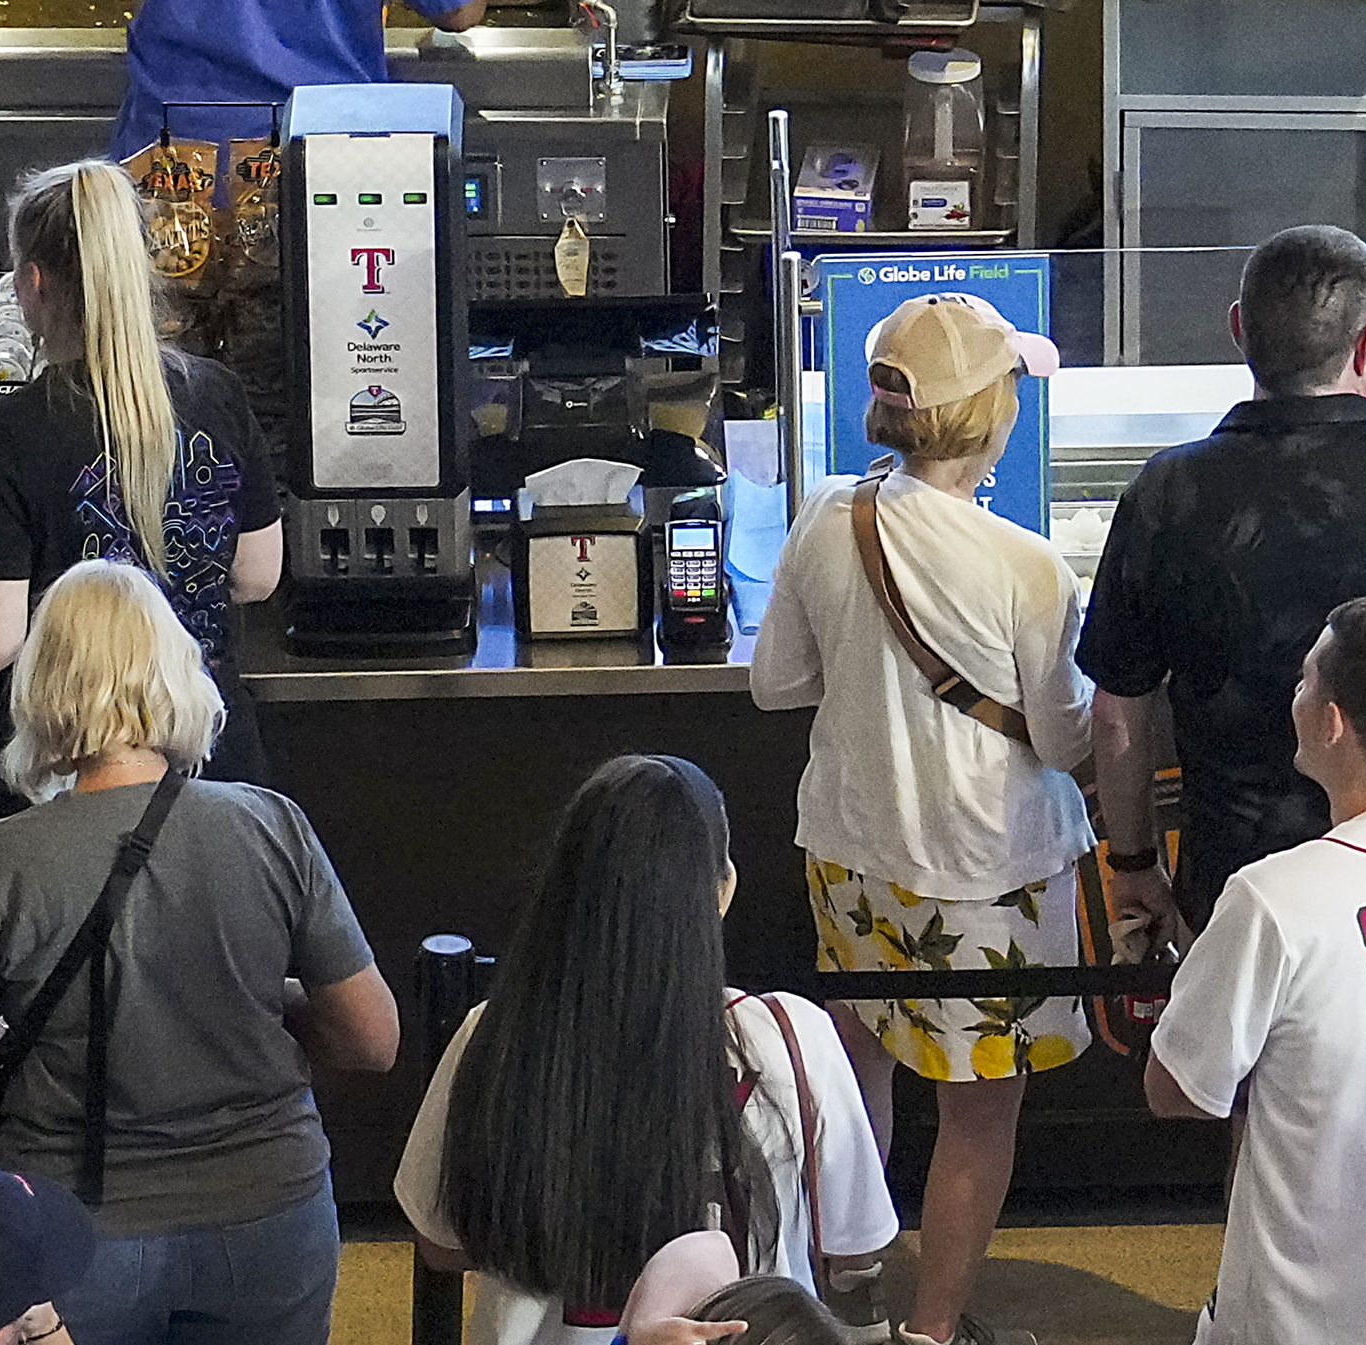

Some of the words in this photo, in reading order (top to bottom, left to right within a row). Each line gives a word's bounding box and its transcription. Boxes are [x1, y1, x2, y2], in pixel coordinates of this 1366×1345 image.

[351, 248, 395, 294] T
[879, 266, 931, 282] Globe
[934, 265, 966, 281] Life
[969, 263, 1010, 279] Field
[347, 342, 401, 352] Delaware
[357, 354, 392, 363] North
[350, 367, 399, 375] Sportservice
[570, 536, 596, 563] T
